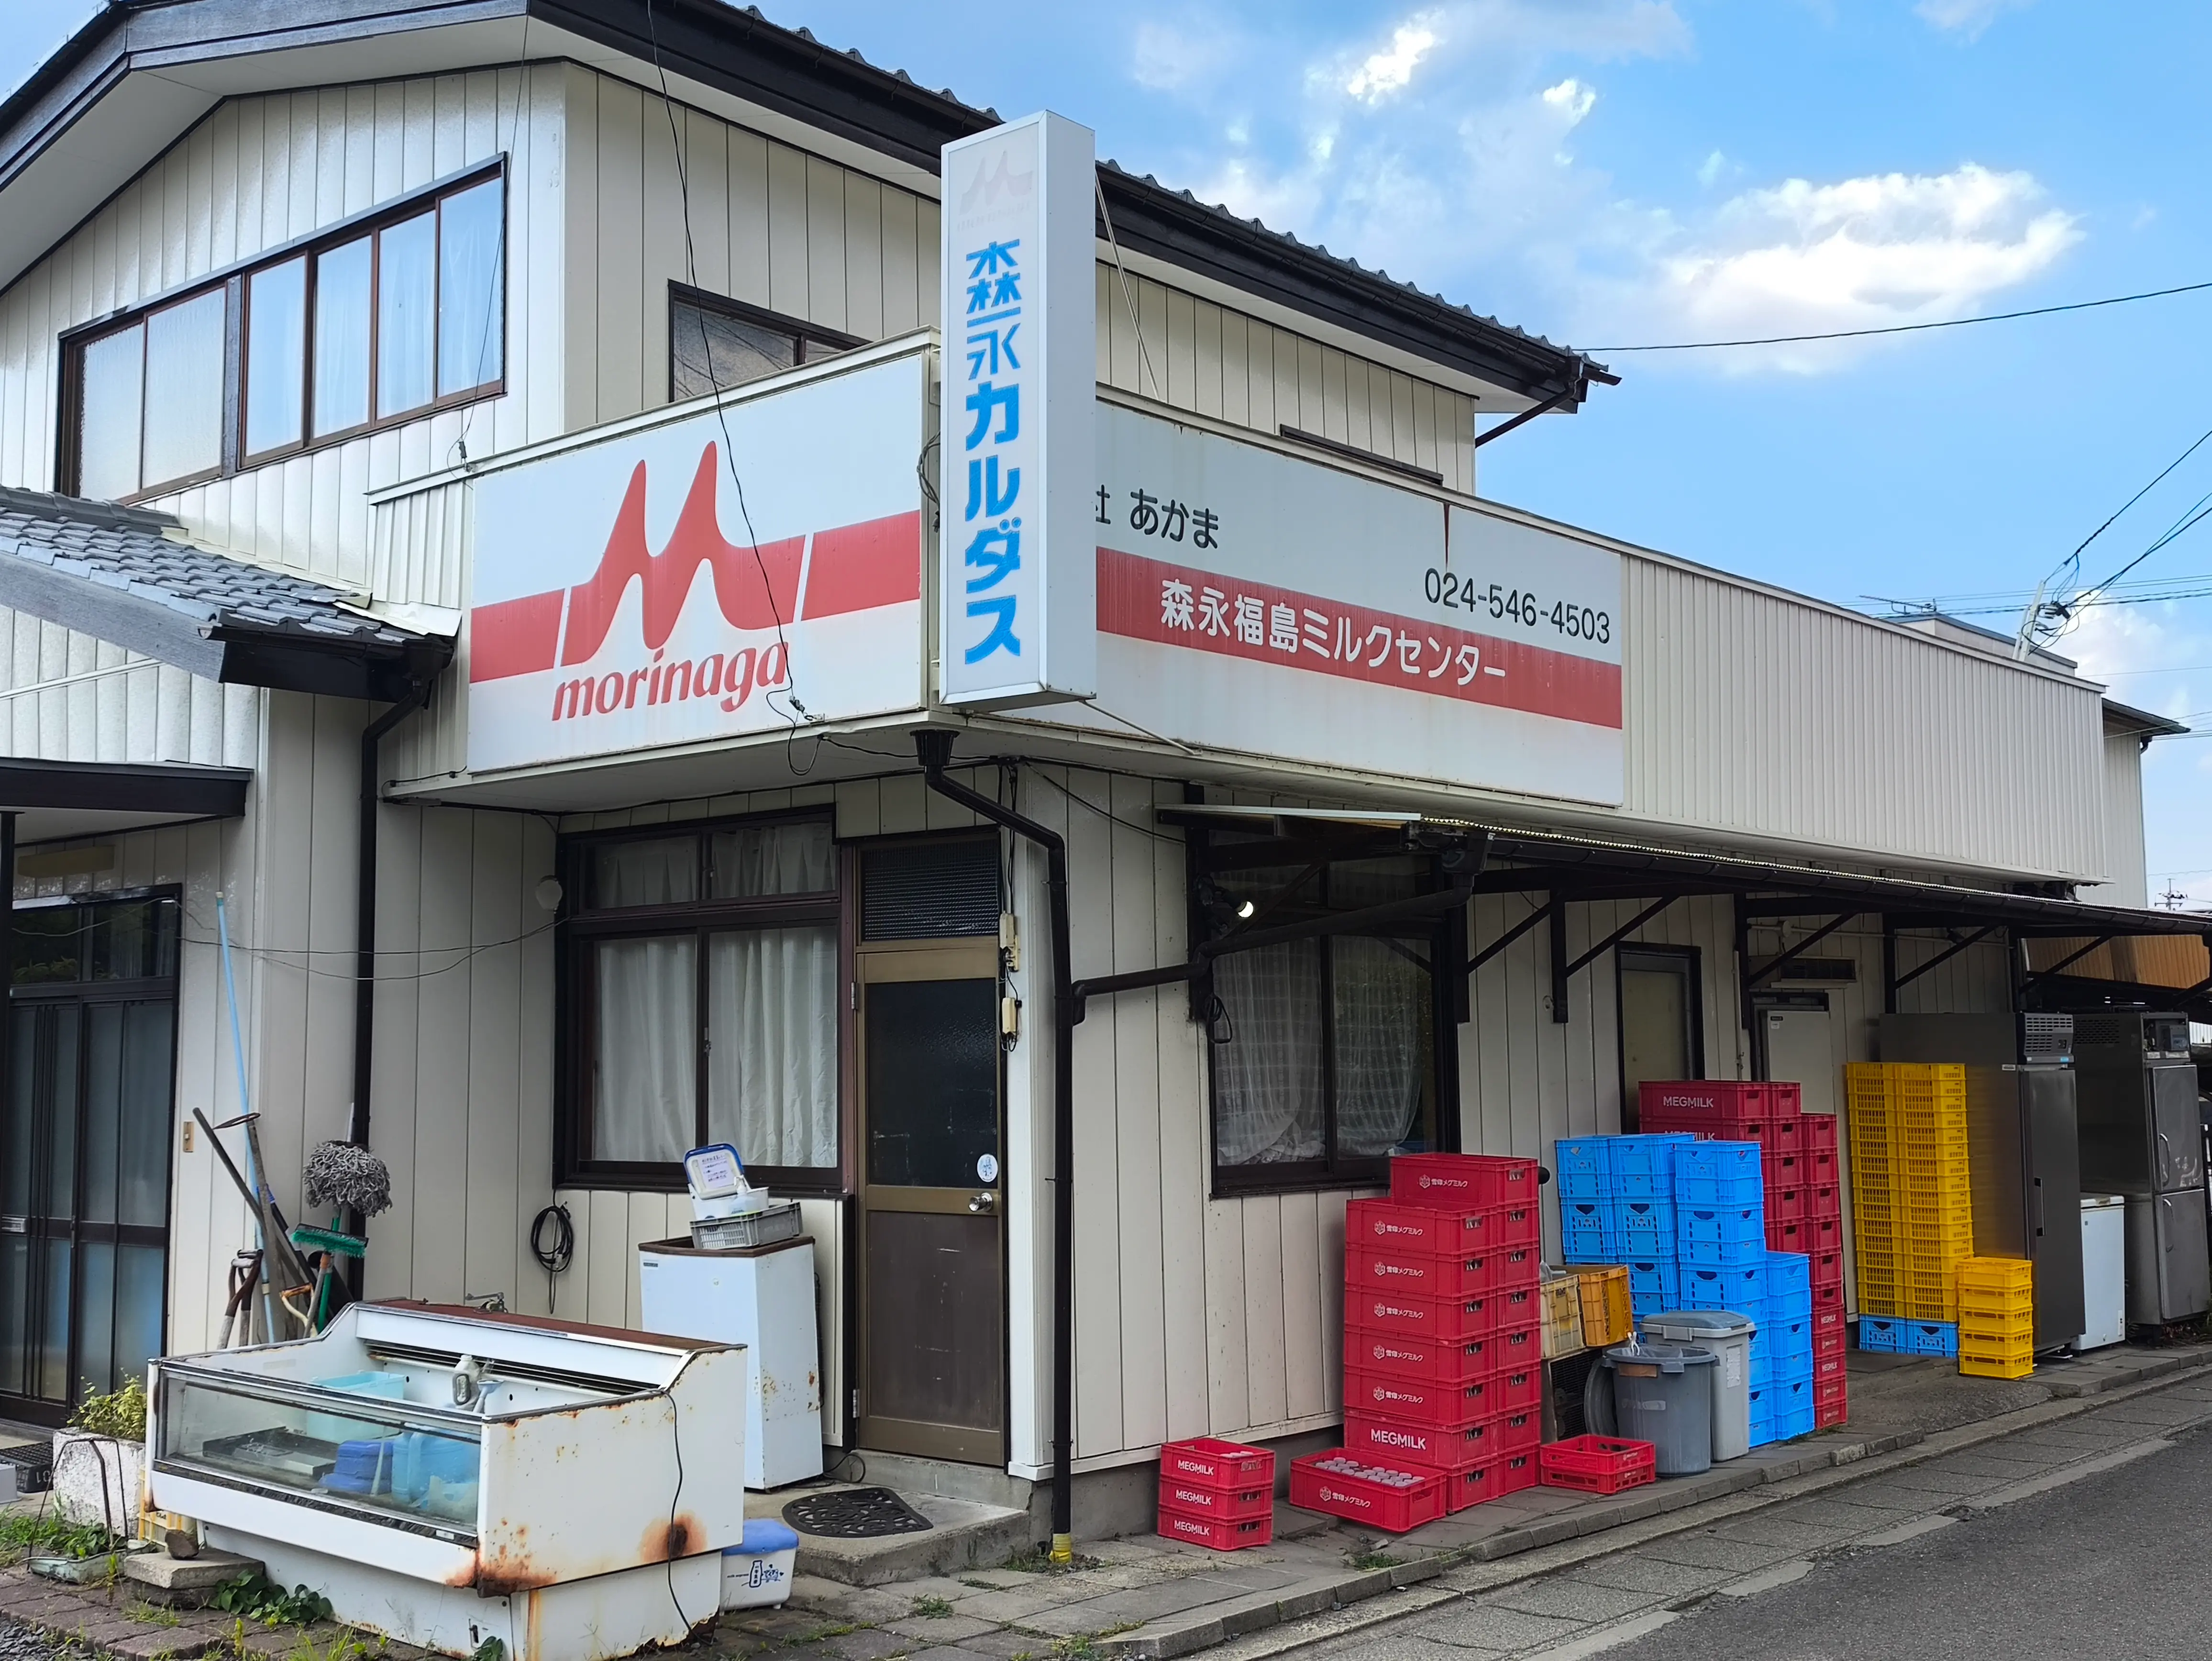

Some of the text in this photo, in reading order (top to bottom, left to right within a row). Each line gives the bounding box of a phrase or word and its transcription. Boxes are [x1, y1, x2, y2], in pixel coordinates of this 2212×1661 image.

[965, 238, 1021, 664] 森永カルダス
[1130, 488, 1218, 549] あかま
[1425, 567, 1610, 644] 024-546-4503
[1161, 578, 1506, 686] 森永福島ミルクセンター
[552, 640, 789, 721] morinaga
[1663, 1096, 1714, 1108] MEGMILK
[1371, 1428, 1426, 1450] MEGMILK
[1178, 1460, 1214, 1475] MEGMILK
[1176, 1489, 1211, 1506] MEGMILK
[1174, 1520, 1209, 1536] MEGMILK
